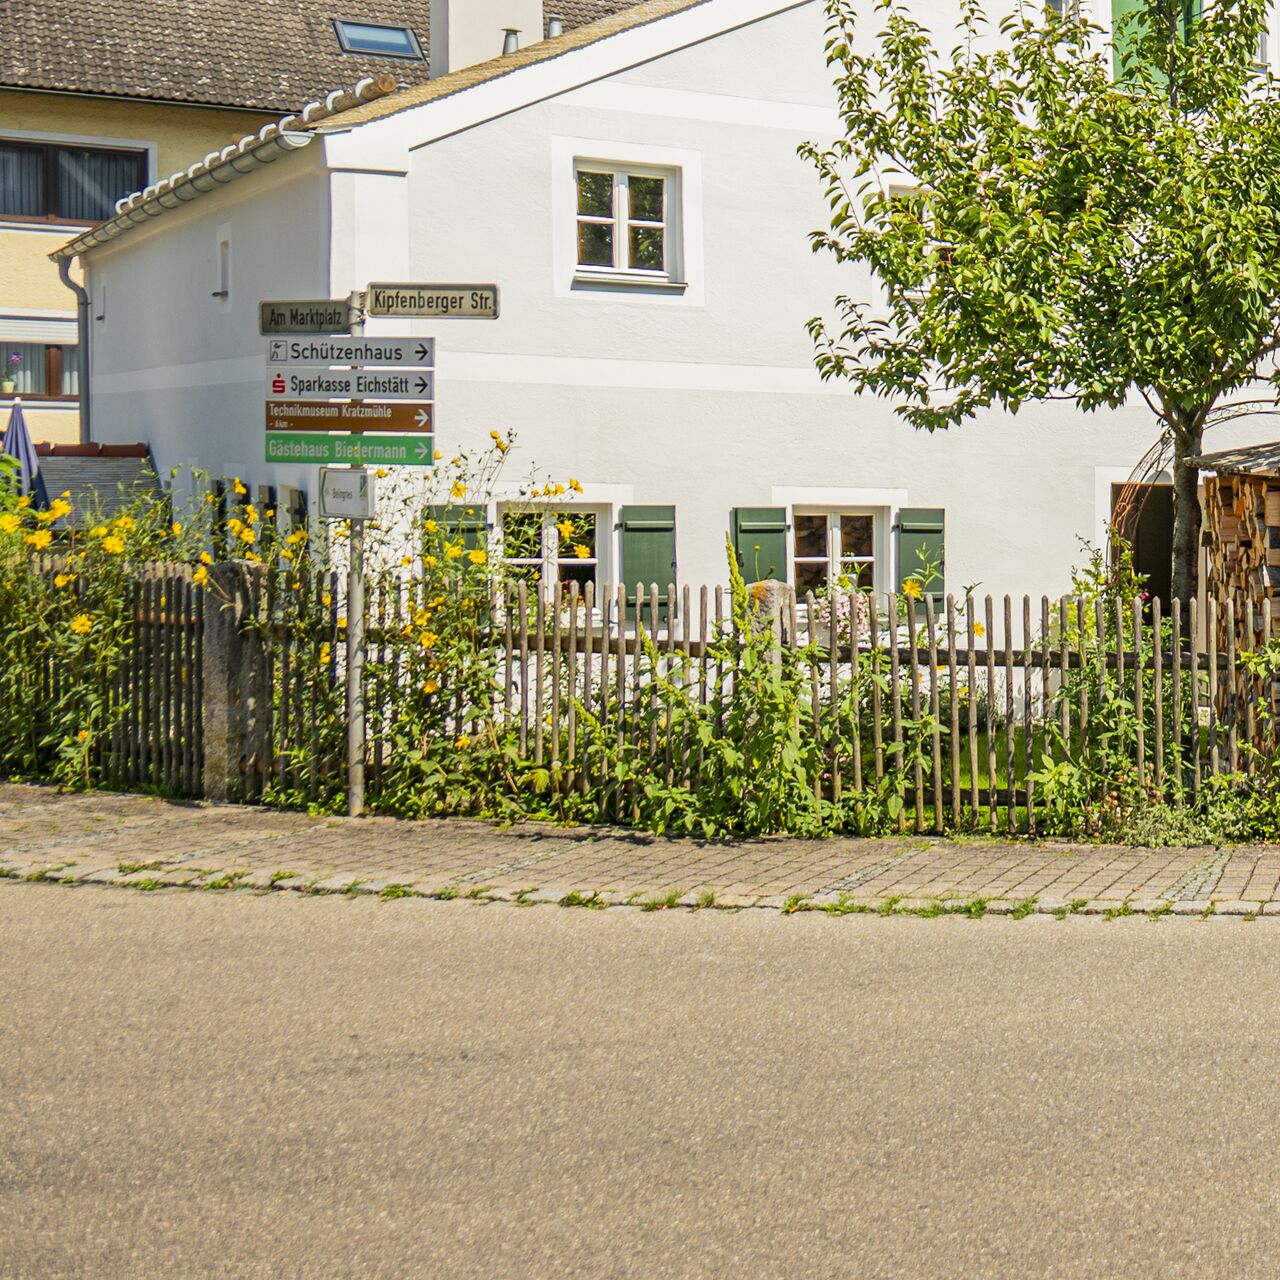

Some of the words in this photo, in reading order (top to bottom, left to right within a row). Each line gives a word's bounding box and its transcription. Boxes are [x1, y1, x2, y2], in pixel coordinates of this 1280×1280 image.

[373, 291, 465, 312] Kipfenberger
[470, 292, 493, 310] Str.
[269, 309, 286, 325] Am
[289, 308, 342, 326] Marktplatz
[290, 342, 403, 361] Schützenhaus
[290, 375, 351, 395] Sparkasse
[356, 376, 410, 394] Eichstätt
[269, 404, 339, 418] Technikmuseum
[341, 404, 392, 419] Kratzmühle
[269, 441, 329, 457] Gästehaus
[334, 441, 407, 459] Biedermann
